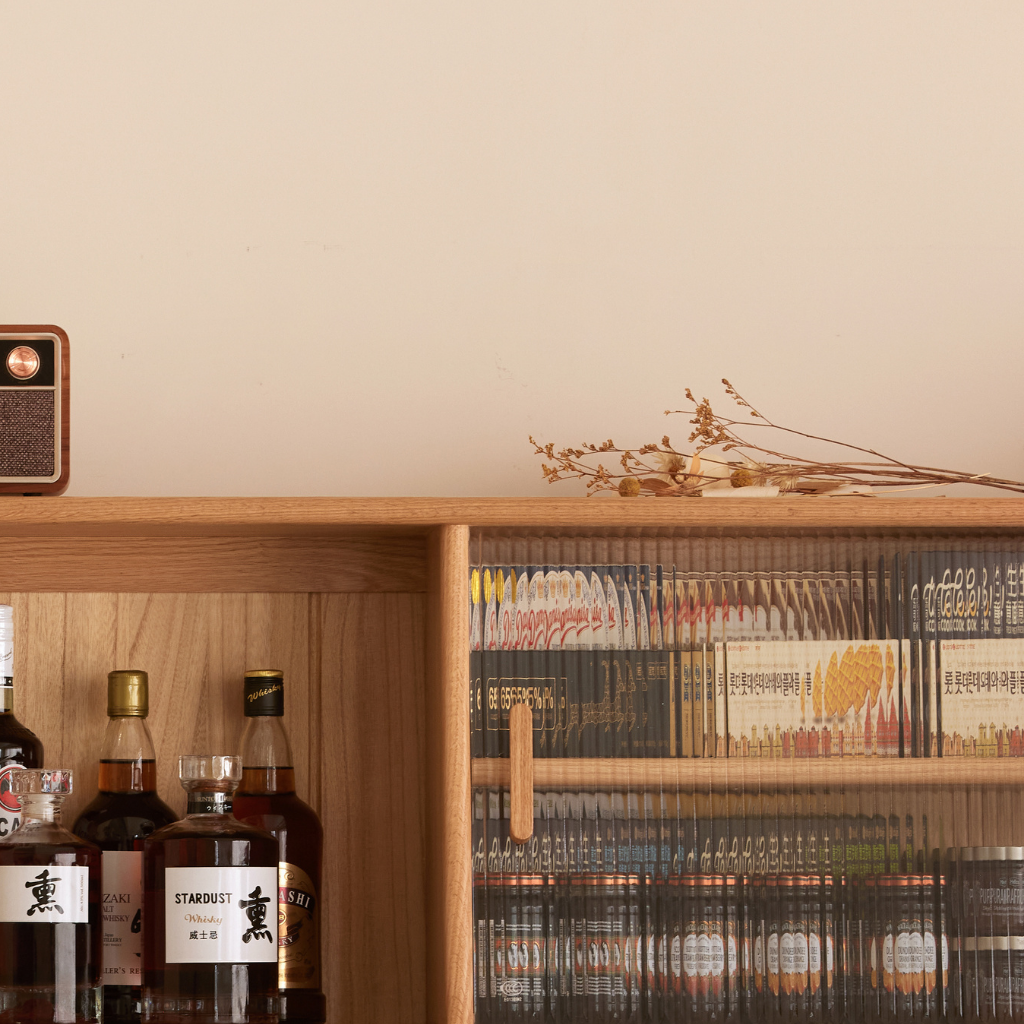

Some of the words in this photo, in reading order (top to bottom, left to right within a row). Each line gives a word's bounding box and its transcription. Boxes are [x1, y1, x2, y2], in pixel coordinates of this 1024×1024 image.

[247, 684, 281, 703] Whisky
[175, 893, 233, 904] STARDUST
[184, 914, 223, 926] Whisky
[189, 930, 218, 940] 威士忌
